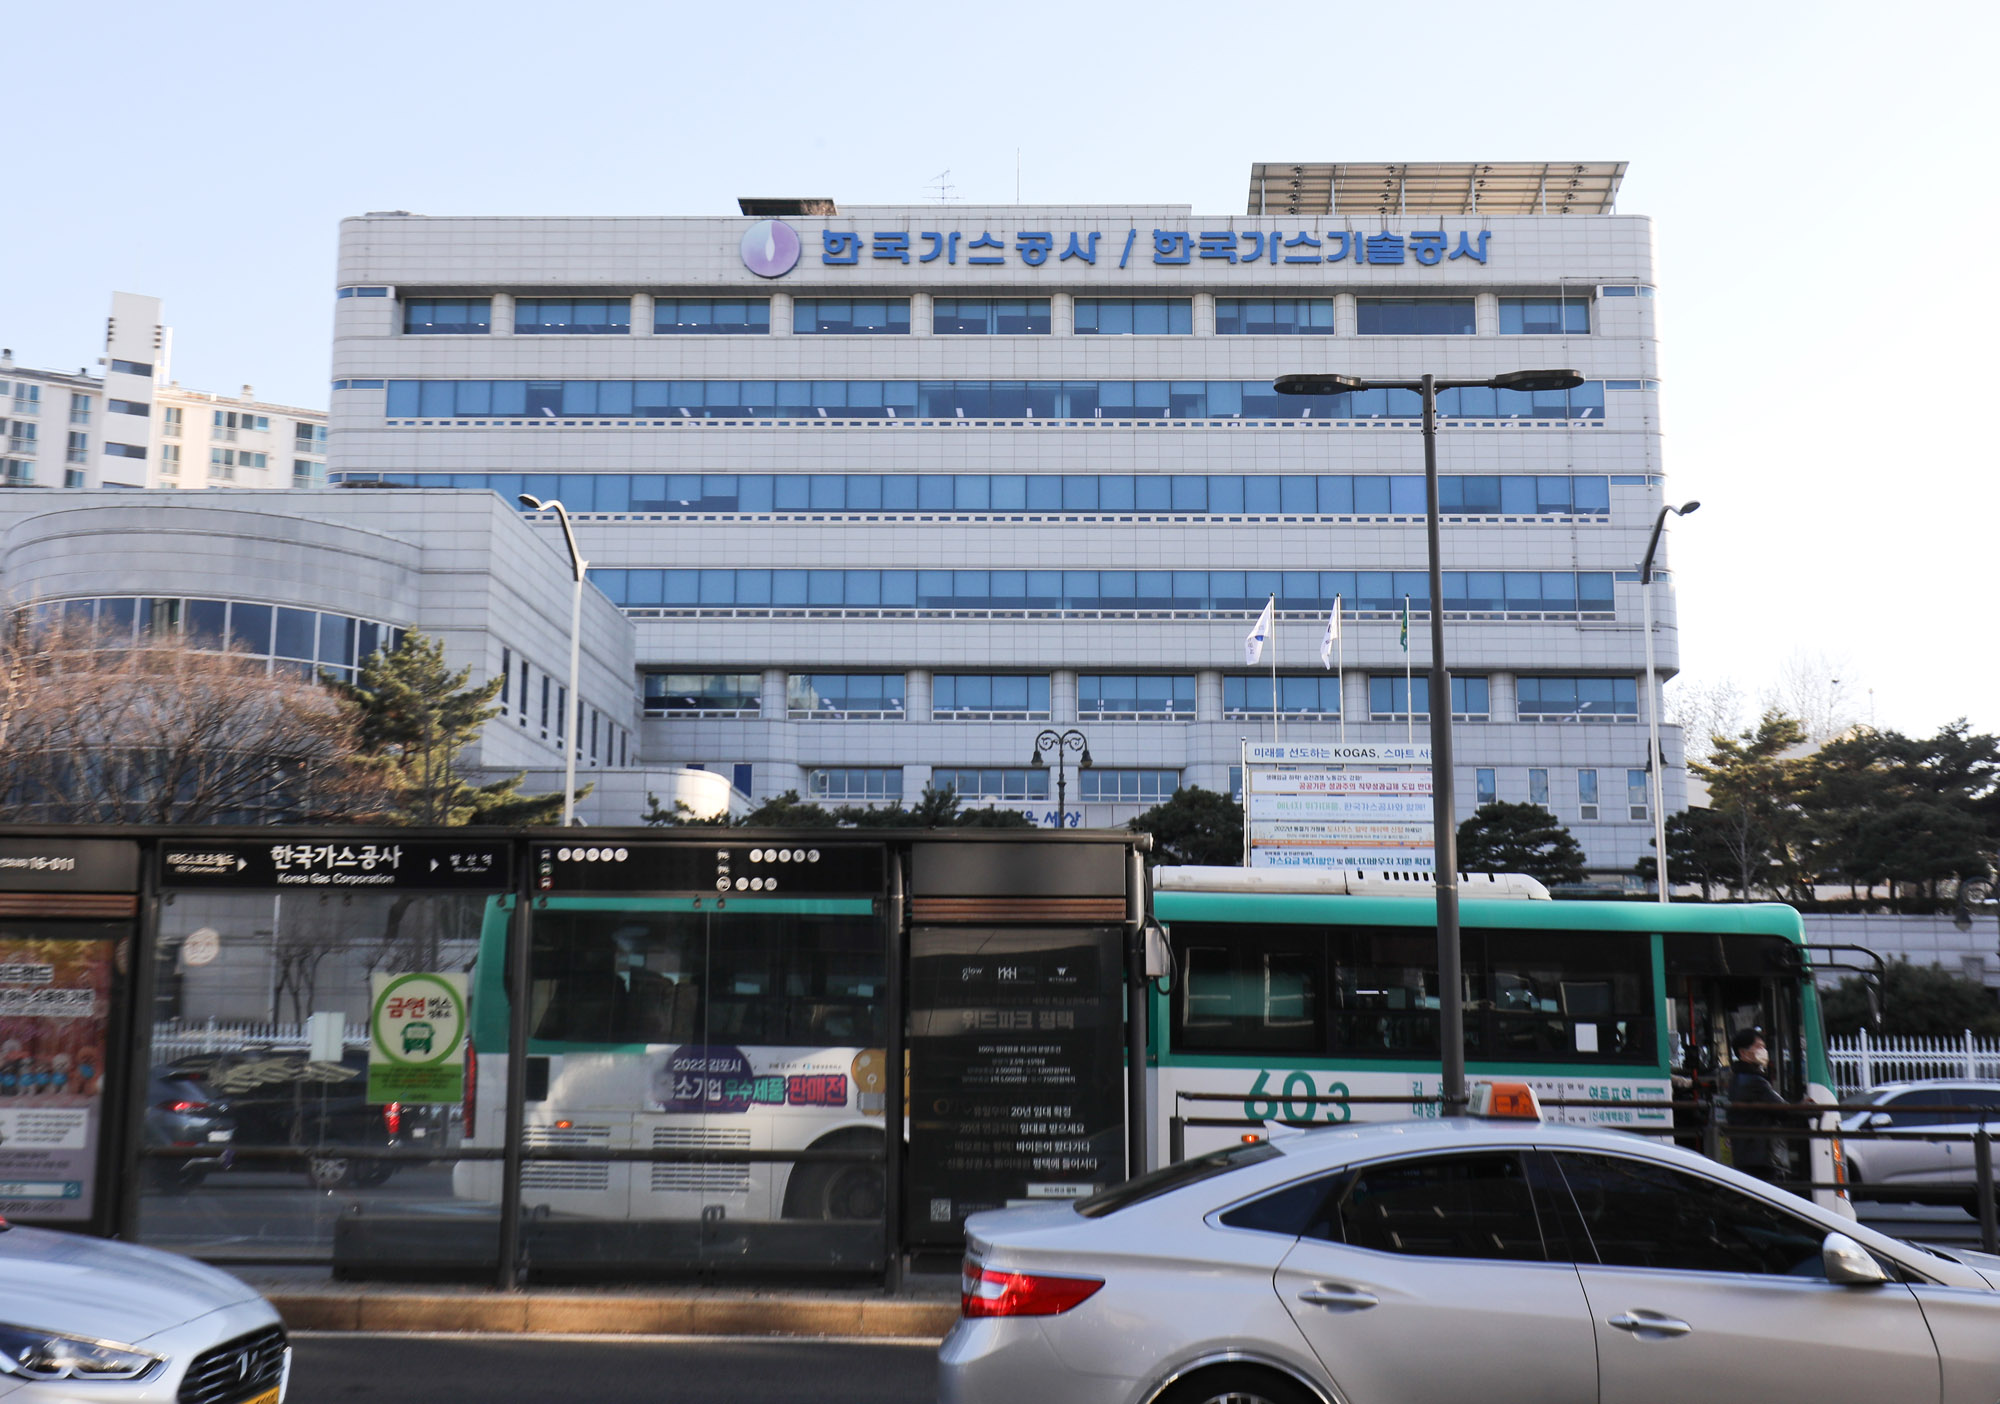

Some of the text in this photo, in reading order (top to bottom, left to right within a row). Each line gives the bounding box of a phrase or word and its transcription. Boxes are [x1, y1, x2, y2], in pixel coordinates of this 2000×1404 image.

[821, 228, 1100, 267] 한국가스공사
[1152, 228, 1492, 267] 한국가스기술공사
[1254, 747, 1432, 760] 미래를 선도하는 KOGAS, 스마트 서
[1329, 783, 1356, 791] 성과주의
[1401, 783, 1415, 791] 도입
[1044, 811, 1081, 828] 세상
[270, 844, 402, 870] 한국가스공사
[1269, 857, 1300, 865] 가스요금
[1302, 857, 1335, 865] 복지할인
[1344, 857, 1394, 865] 에너지바우처
[1396, 857, 1412, 865] 지원
[1414, 857, 1431, 865] 확대
[277, 872, 395, 886] Korea Gas Corporation
[386, 997, 426, 1018] 금연
[962, 1010, 1075, 1030] 위드파크 평택
[674, 1059, 742, 1072] 2022 김포시
[671, 1076, 846, 1103] 소기업 우수제품 판매전
[1010, 1105, 1031, 1118] 20년
[1033, 1105, 1051, 1118] 임대
[1019, 1122, 1047, 1135] 임대료
[1032, 1157, 1060, 1171] 평택에
